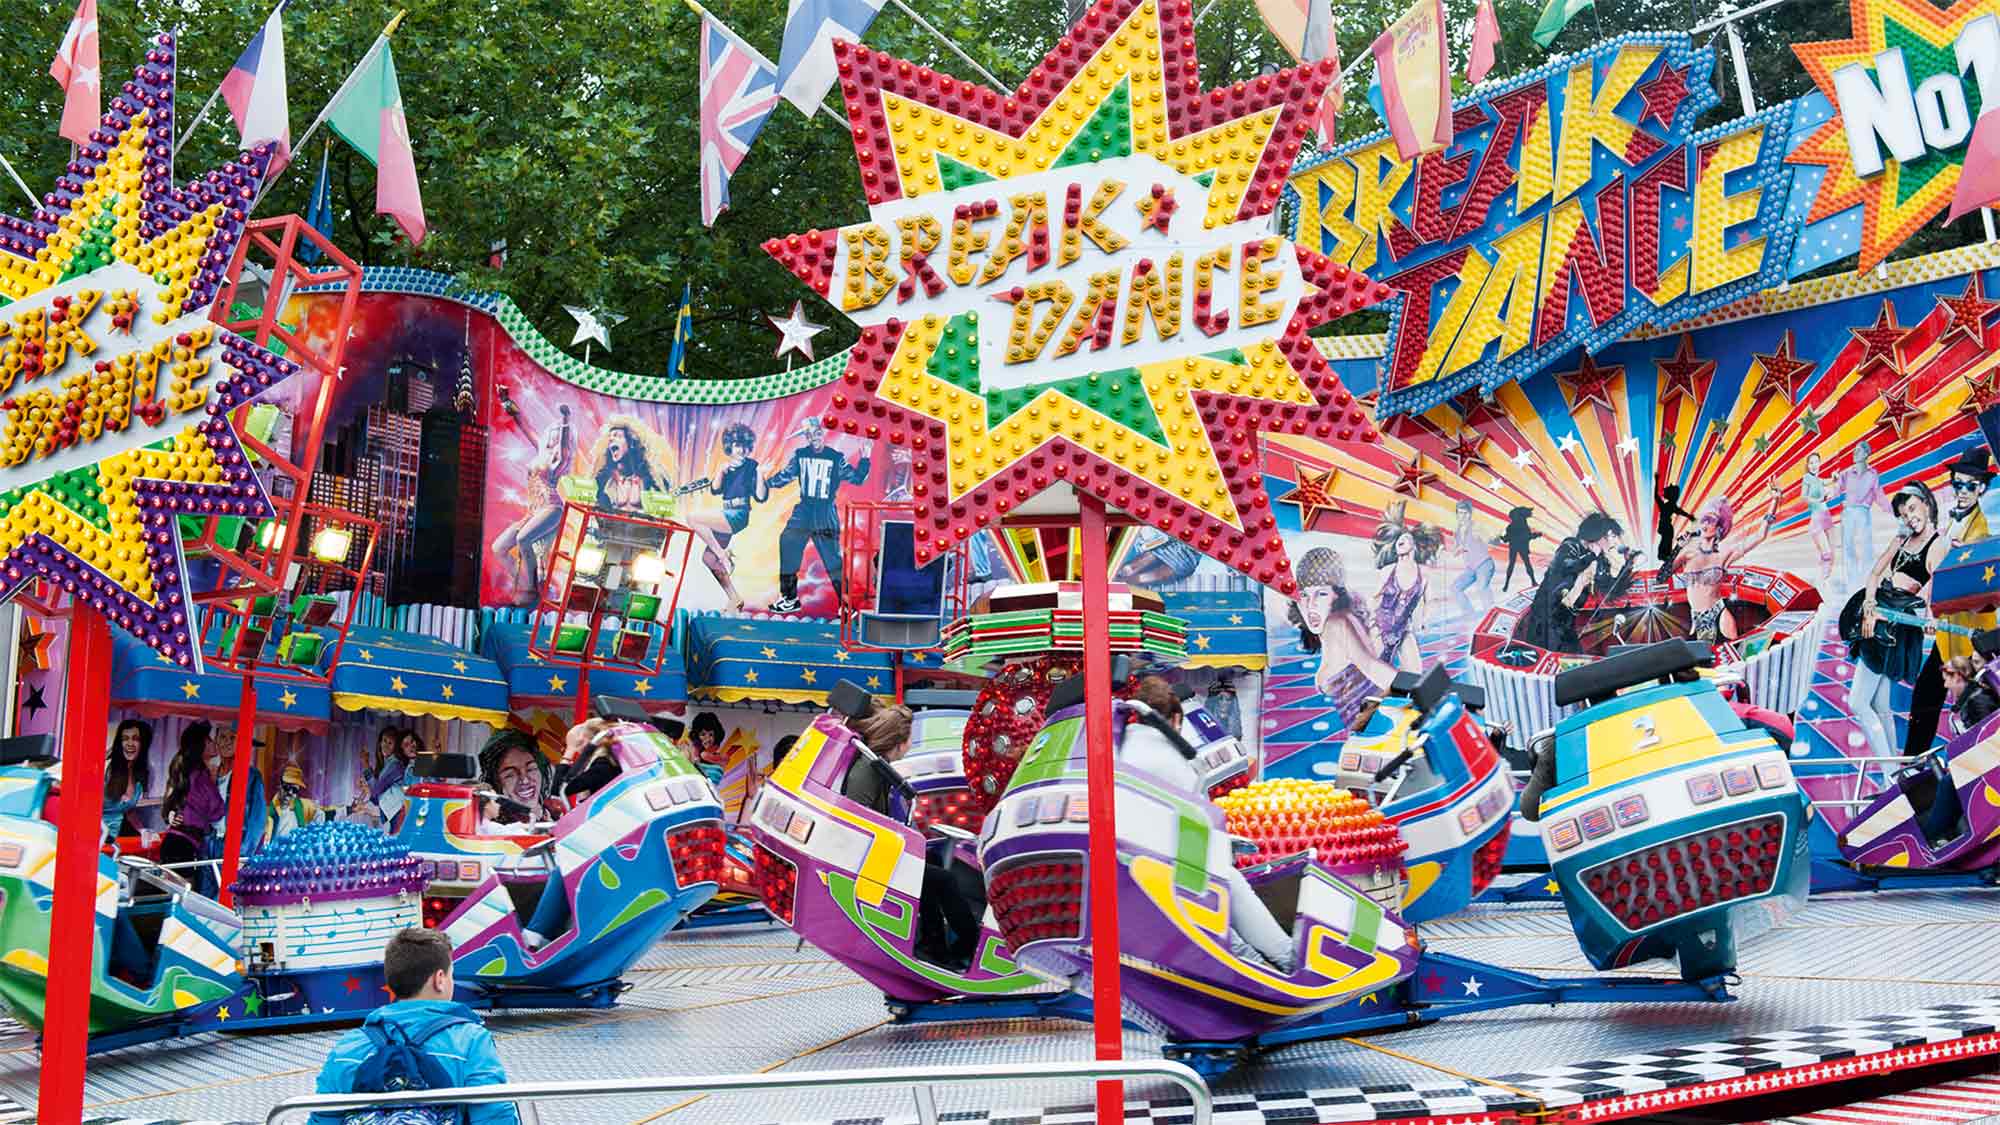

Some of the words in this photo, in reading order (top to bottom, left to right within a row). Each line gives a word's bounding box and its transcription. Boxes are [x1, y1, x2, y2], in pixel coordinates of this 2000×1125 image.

[1287, 44, 1667, 273] BREAK
[841, 179, 1131, 312] BREAK
[991, 235, 1288, 365] DANCE
[1378, 124, 1769, 392] DANCE
[0, 322, 217, 468] DANCE
[1631, 714, 1662, 752] 2
